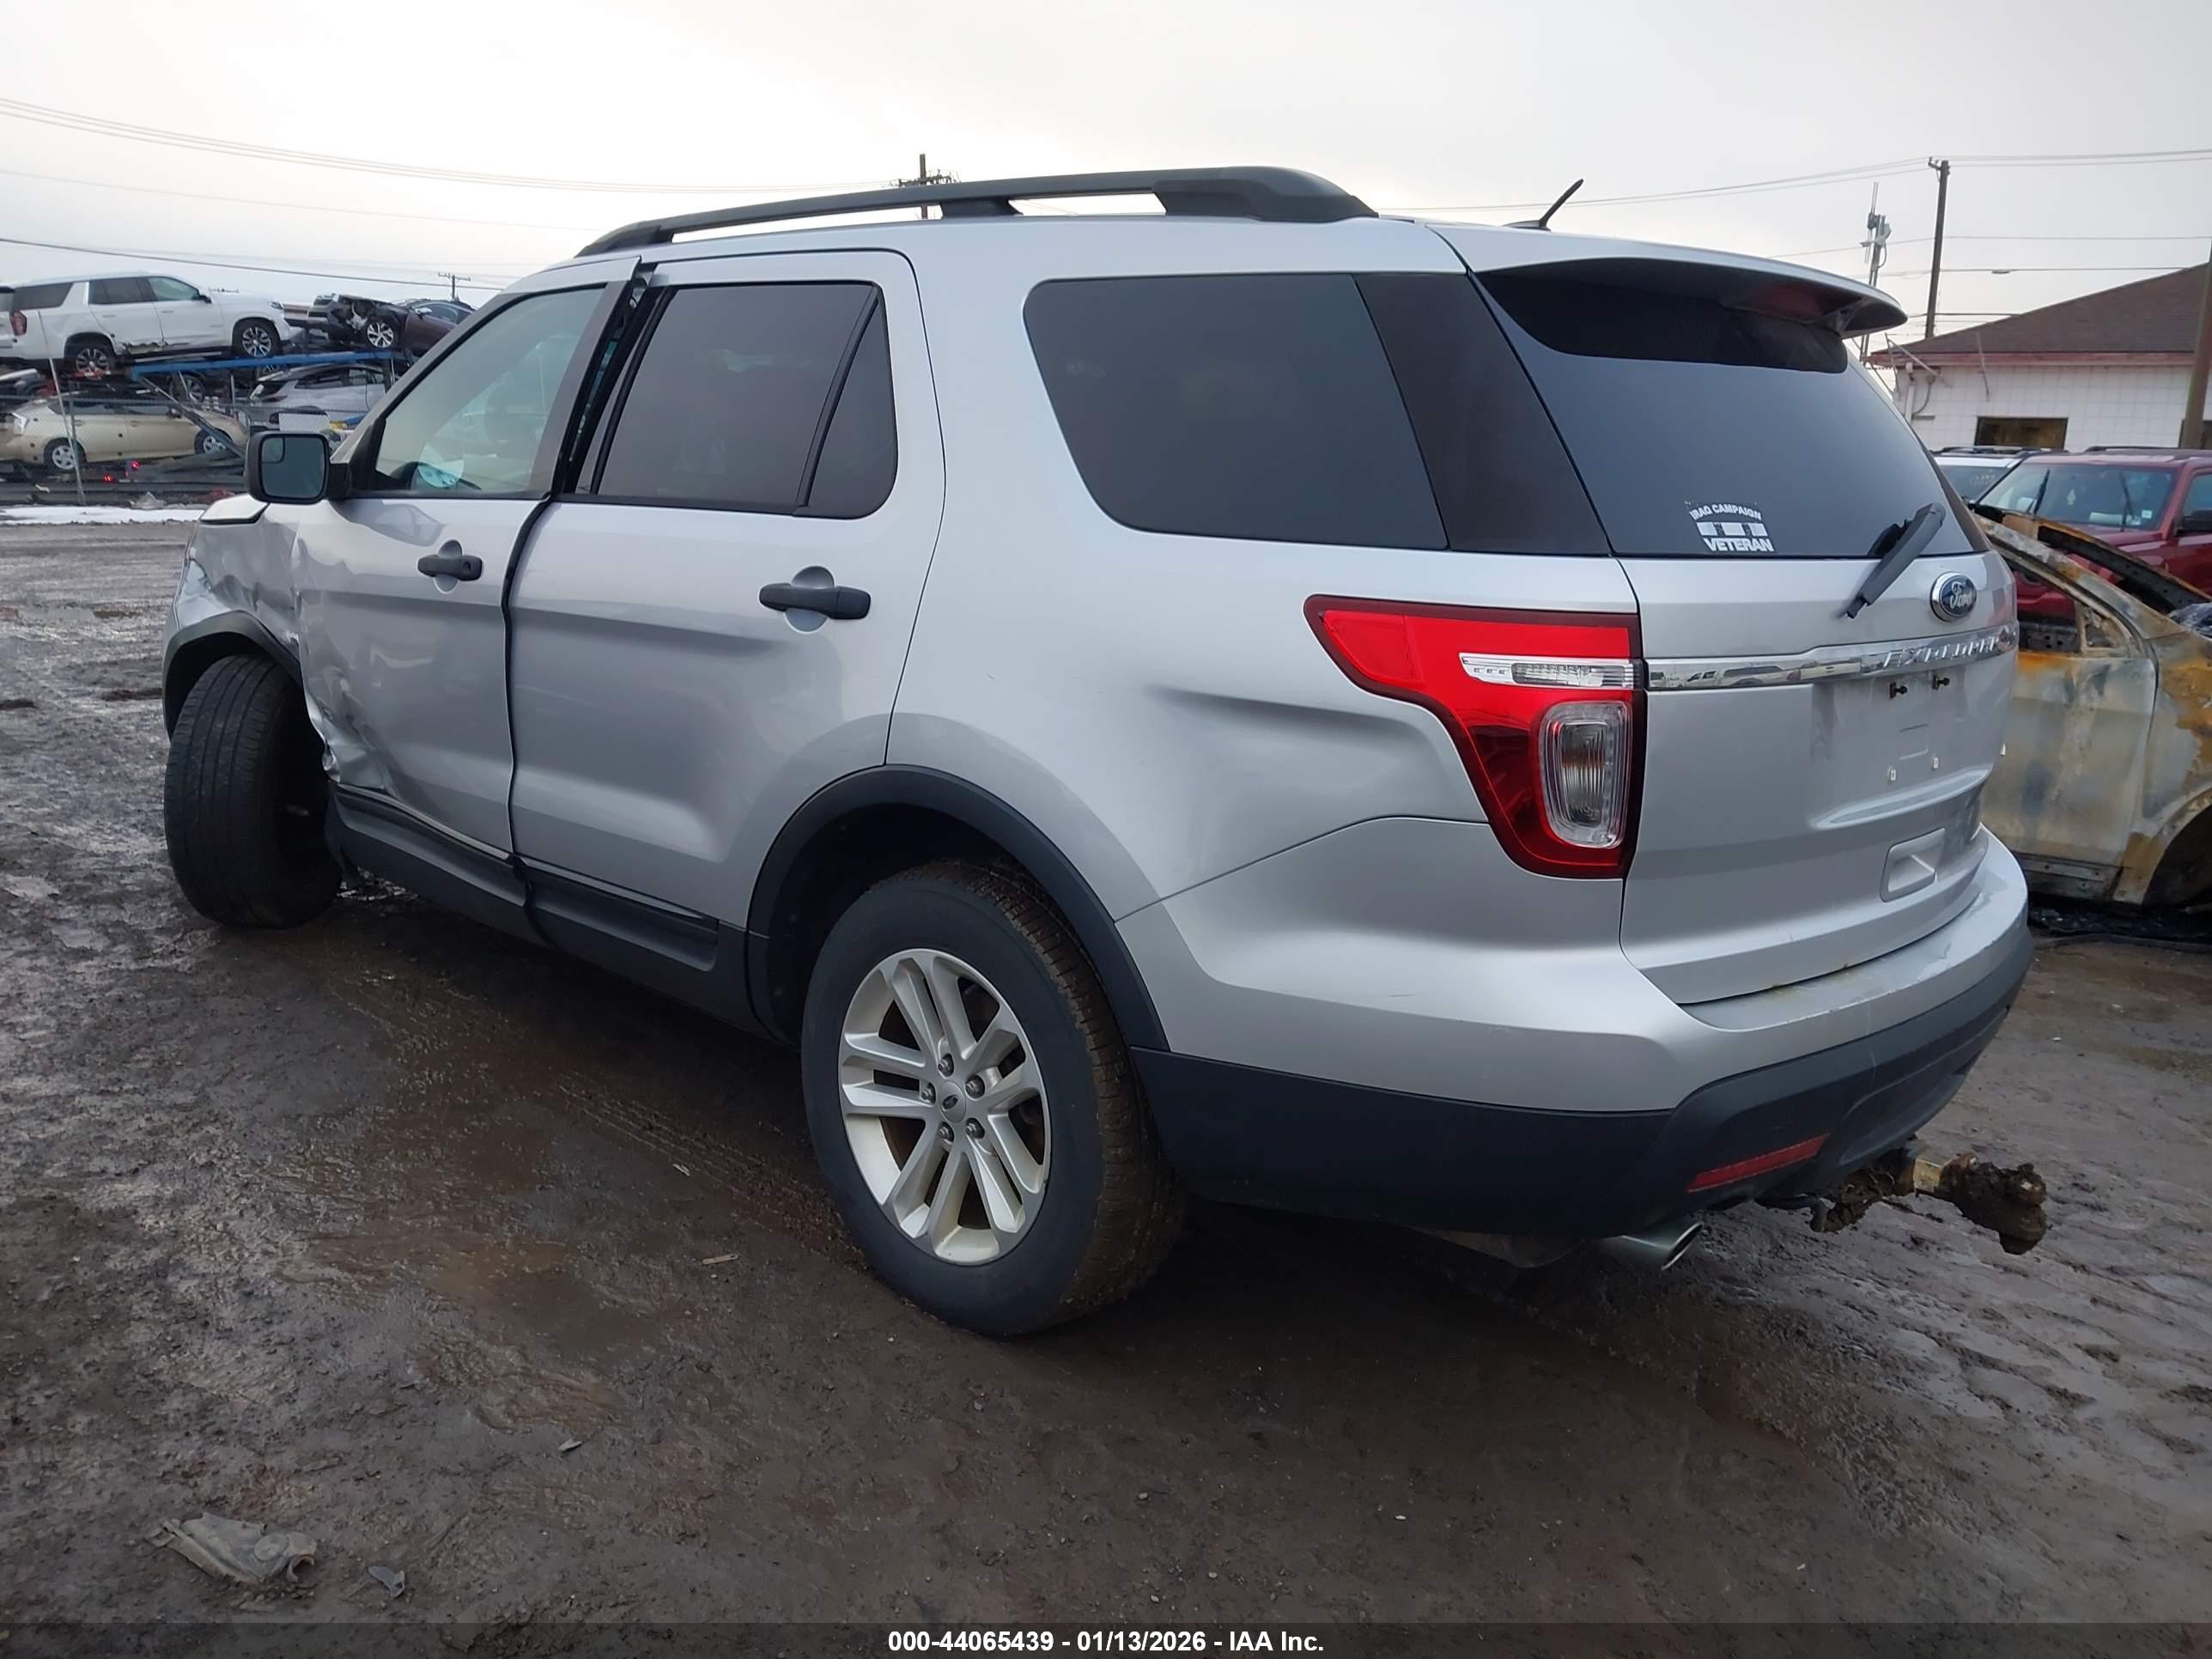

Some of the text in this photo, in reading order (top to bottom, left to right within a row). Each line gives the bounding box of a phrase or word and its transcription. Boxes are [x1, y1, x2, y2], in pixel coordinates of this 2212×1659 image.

[1689, 503, 1762, 520] IRAQ CAMPAIGN
[1702, 538, 1775, 552] VETERAN
[1949, 581, 1973, 609] Ford
